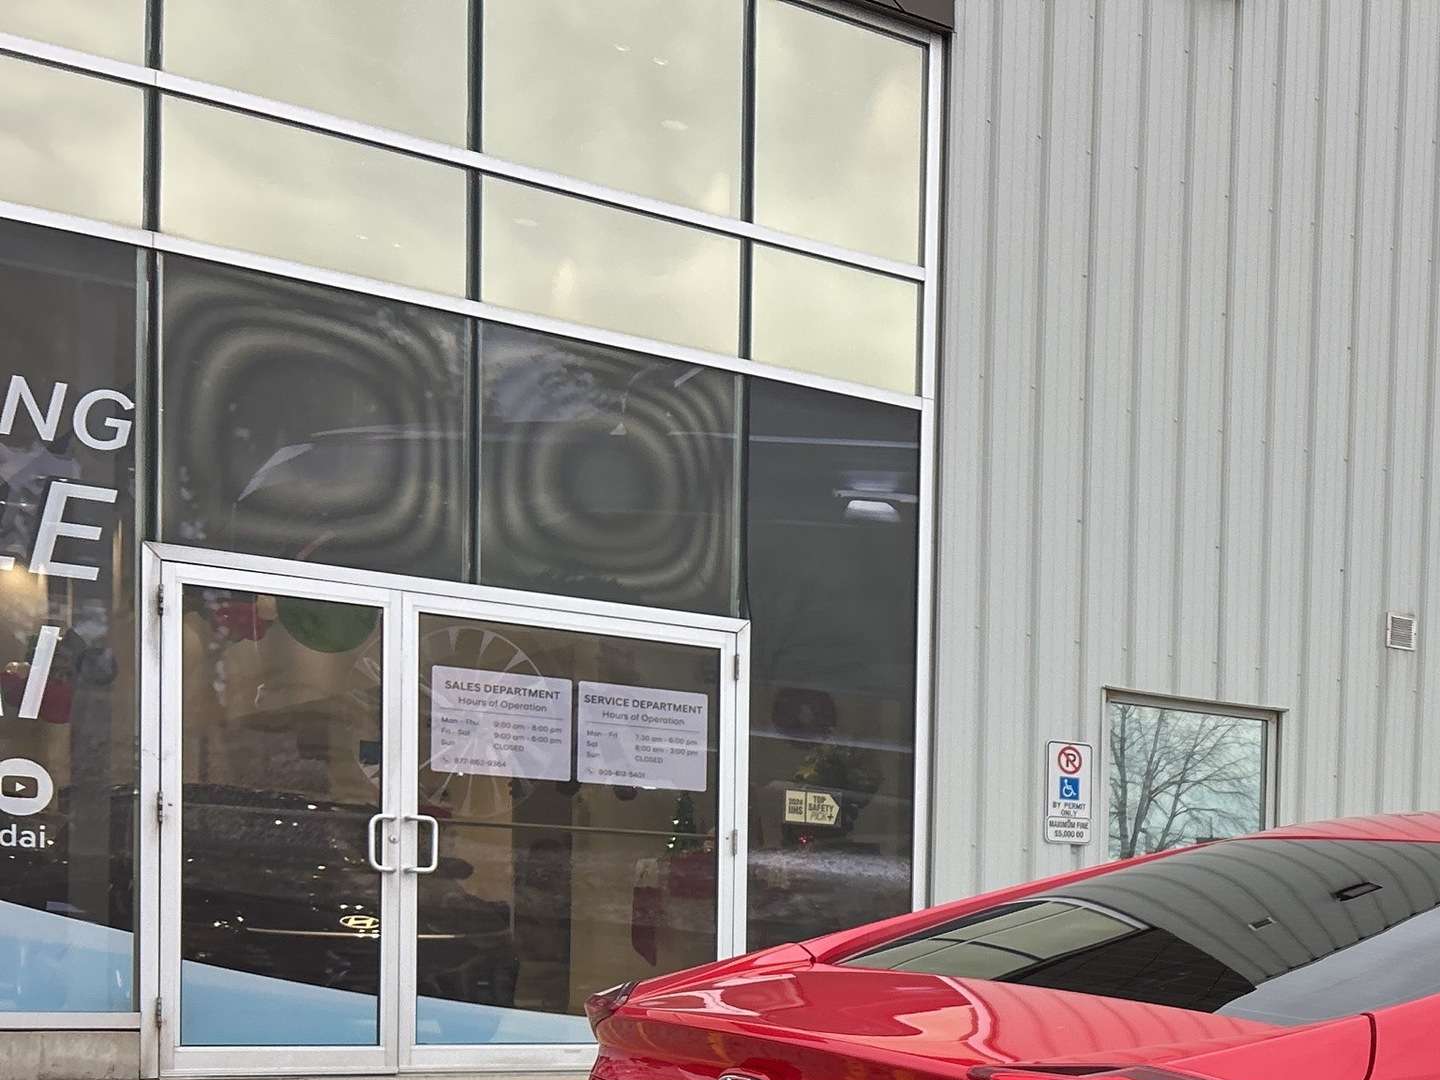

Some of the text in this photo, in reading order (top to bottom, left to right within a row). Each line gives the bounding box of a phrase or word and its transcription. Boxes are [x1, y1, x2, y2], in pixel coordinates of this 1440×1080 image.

[444, 680, 561, 700] SALES DEPARTMENT
[458, 696, 548, 713] Hours of Operation
[584, 694, 704, 715] SERVICE DEPARTMENT
[602, 710, 685, 726] Hours of Operation
[493, 743, 525, 753] CLOSED
[634, 755, 664, 765] CLOSED
[813, 795, 826, 804] TOP
[808, 803, 834, 813] SAFETY
[1052, 801, 1087, 811] BY PERMIT
[1060, 809, 1078, 817] ONLY
